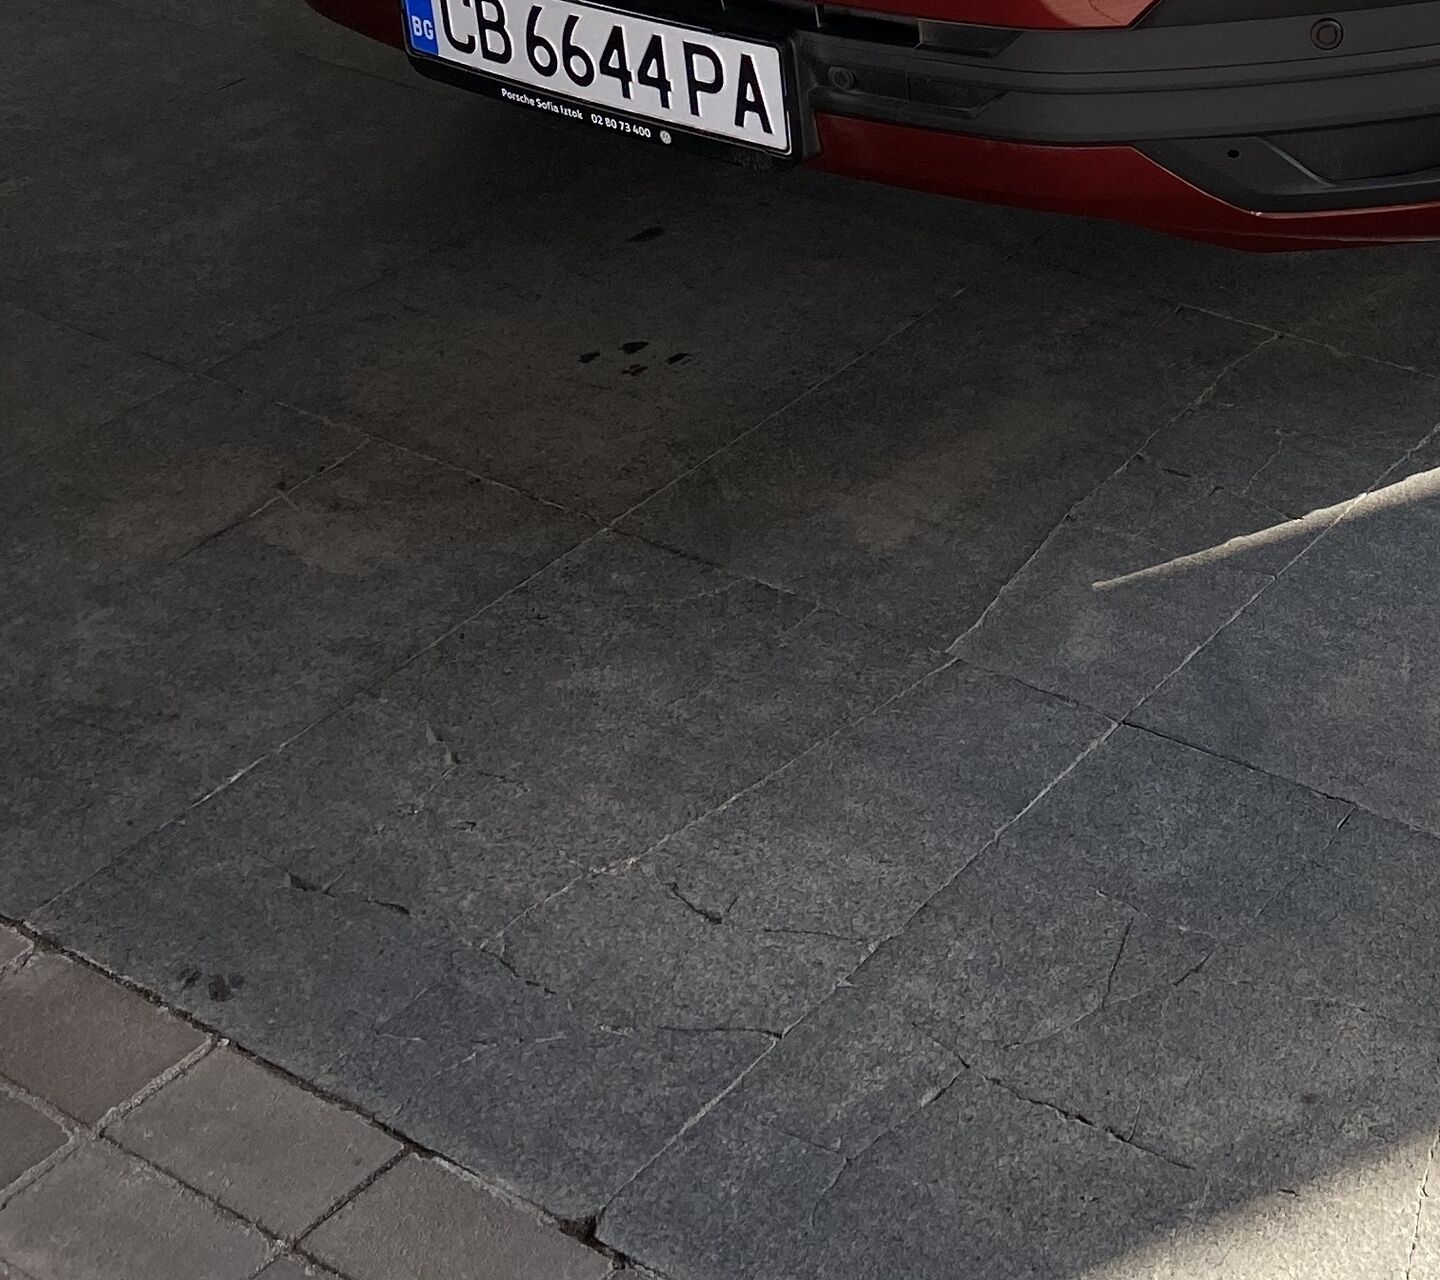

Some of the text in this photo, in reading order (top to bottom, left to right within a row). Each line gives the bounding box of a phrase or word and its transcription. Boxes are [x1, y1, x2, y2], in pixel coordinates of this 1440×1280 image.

[411, 14, 435, 42] BG
[501, 88, 536, 107] Porsche
[536, 98, 559, 114] Sofia
[590, 113, 603, 126] 02
[618, 120, 632, 133] 73
[632, 124, 651, 138] 400
